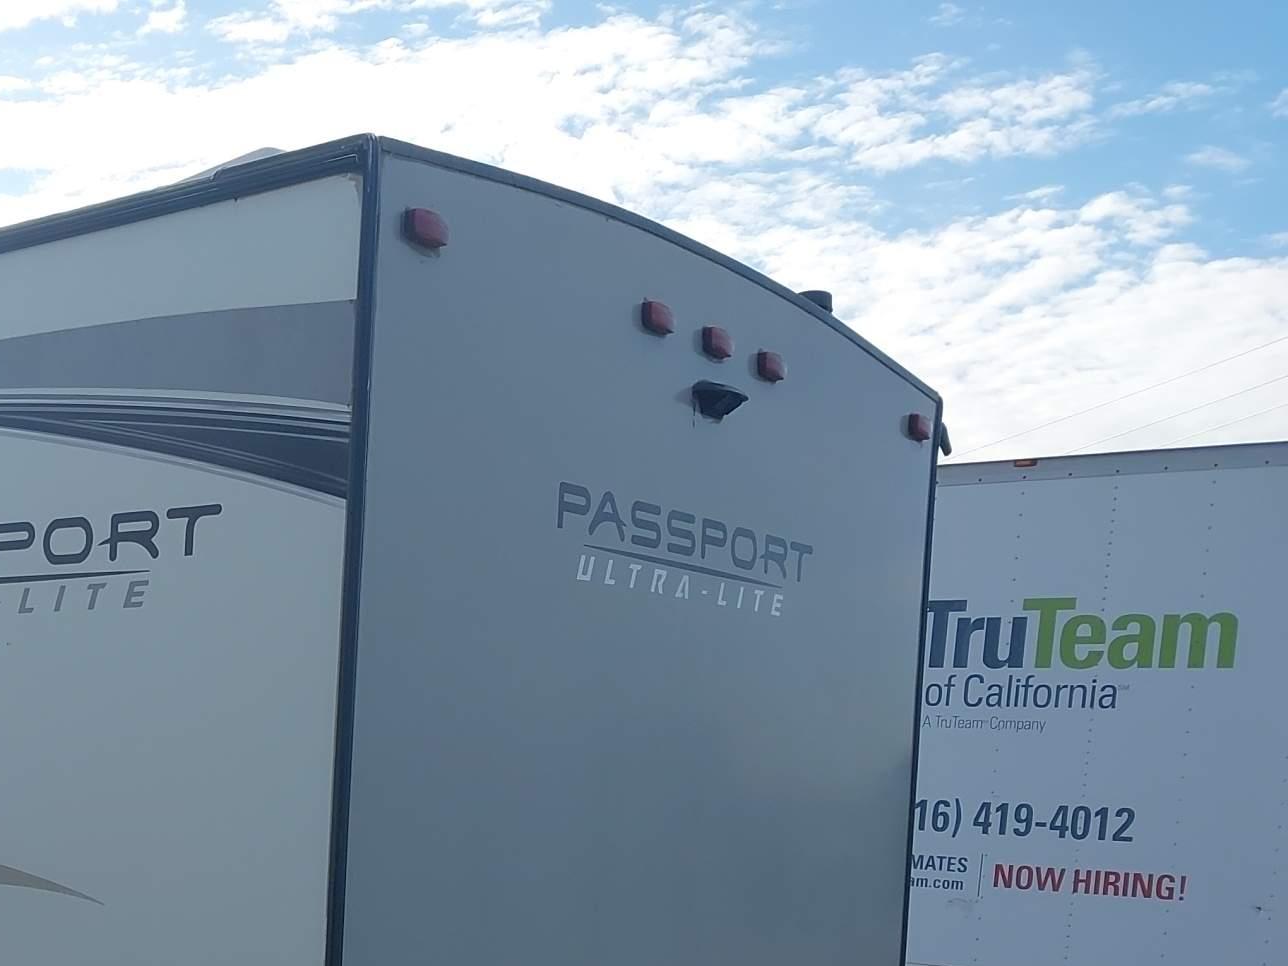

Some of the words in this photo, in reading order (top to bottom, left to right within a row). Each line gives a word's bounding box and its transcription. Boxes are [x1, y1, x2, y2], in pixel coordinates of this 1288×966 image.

[557, 481, 813, 582] PASSPORT
[576, 554, 784, 616] ULTRA-LITE
[927, 597, 1239, 669] TruTeam
[925, 674, 958, 707] of
[963, 674, 1119, 710] California
[922, 714, 932, 729] A
[989, 715, 1047, 734] Company
[972, 801, 1136, 843] 419-4012
[992, 863, 1066, 893] NOW
[1072, 868, 1188, 902] HIRING!
